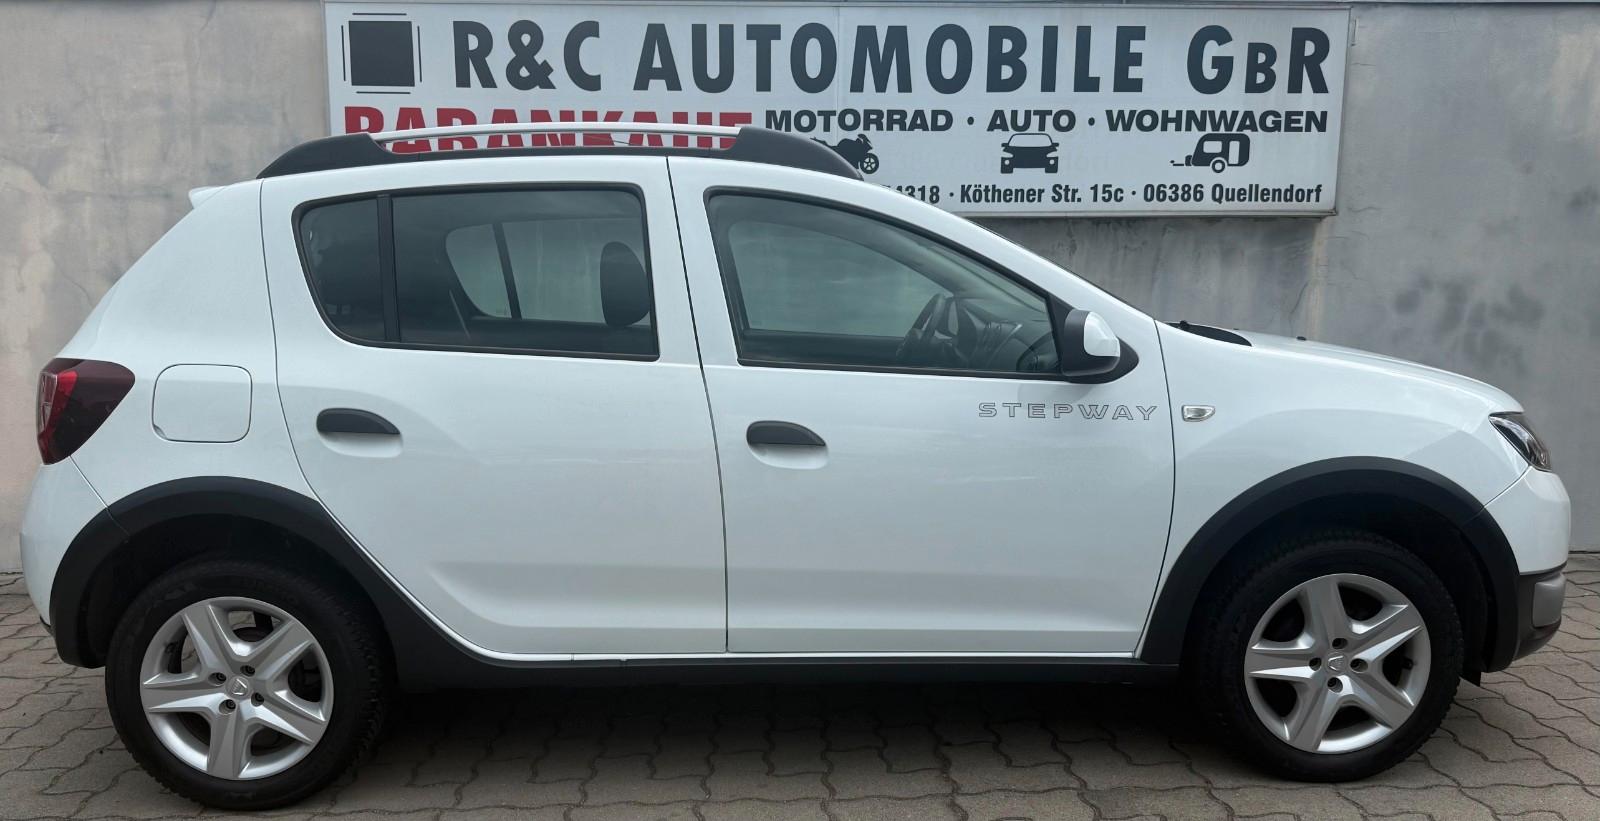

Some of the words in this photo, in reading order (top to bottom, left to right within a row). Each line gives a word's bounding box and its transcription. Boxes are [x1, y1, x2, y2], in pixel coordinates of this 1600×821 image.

[453, 20, 601, 91] R&C
[633, 23, 1146, 94] AUTOMOBILE
[765, 109, 953, 133] MOTORRAD
[987, 110, 1076, 132] AUTO
[1106, 110, 1327, 133] WOHNWAGEN
[961, 184, 1044, 203] Köthener
[1052, 184, 1081, 203] Str.
[1090, 184, 1124, 203] 15c
[1144, 184, 1204, 203] 06386
[1212, 184, 1322, 205] Quellendorf
[979, 402, 1158, 420] STEPWAY
